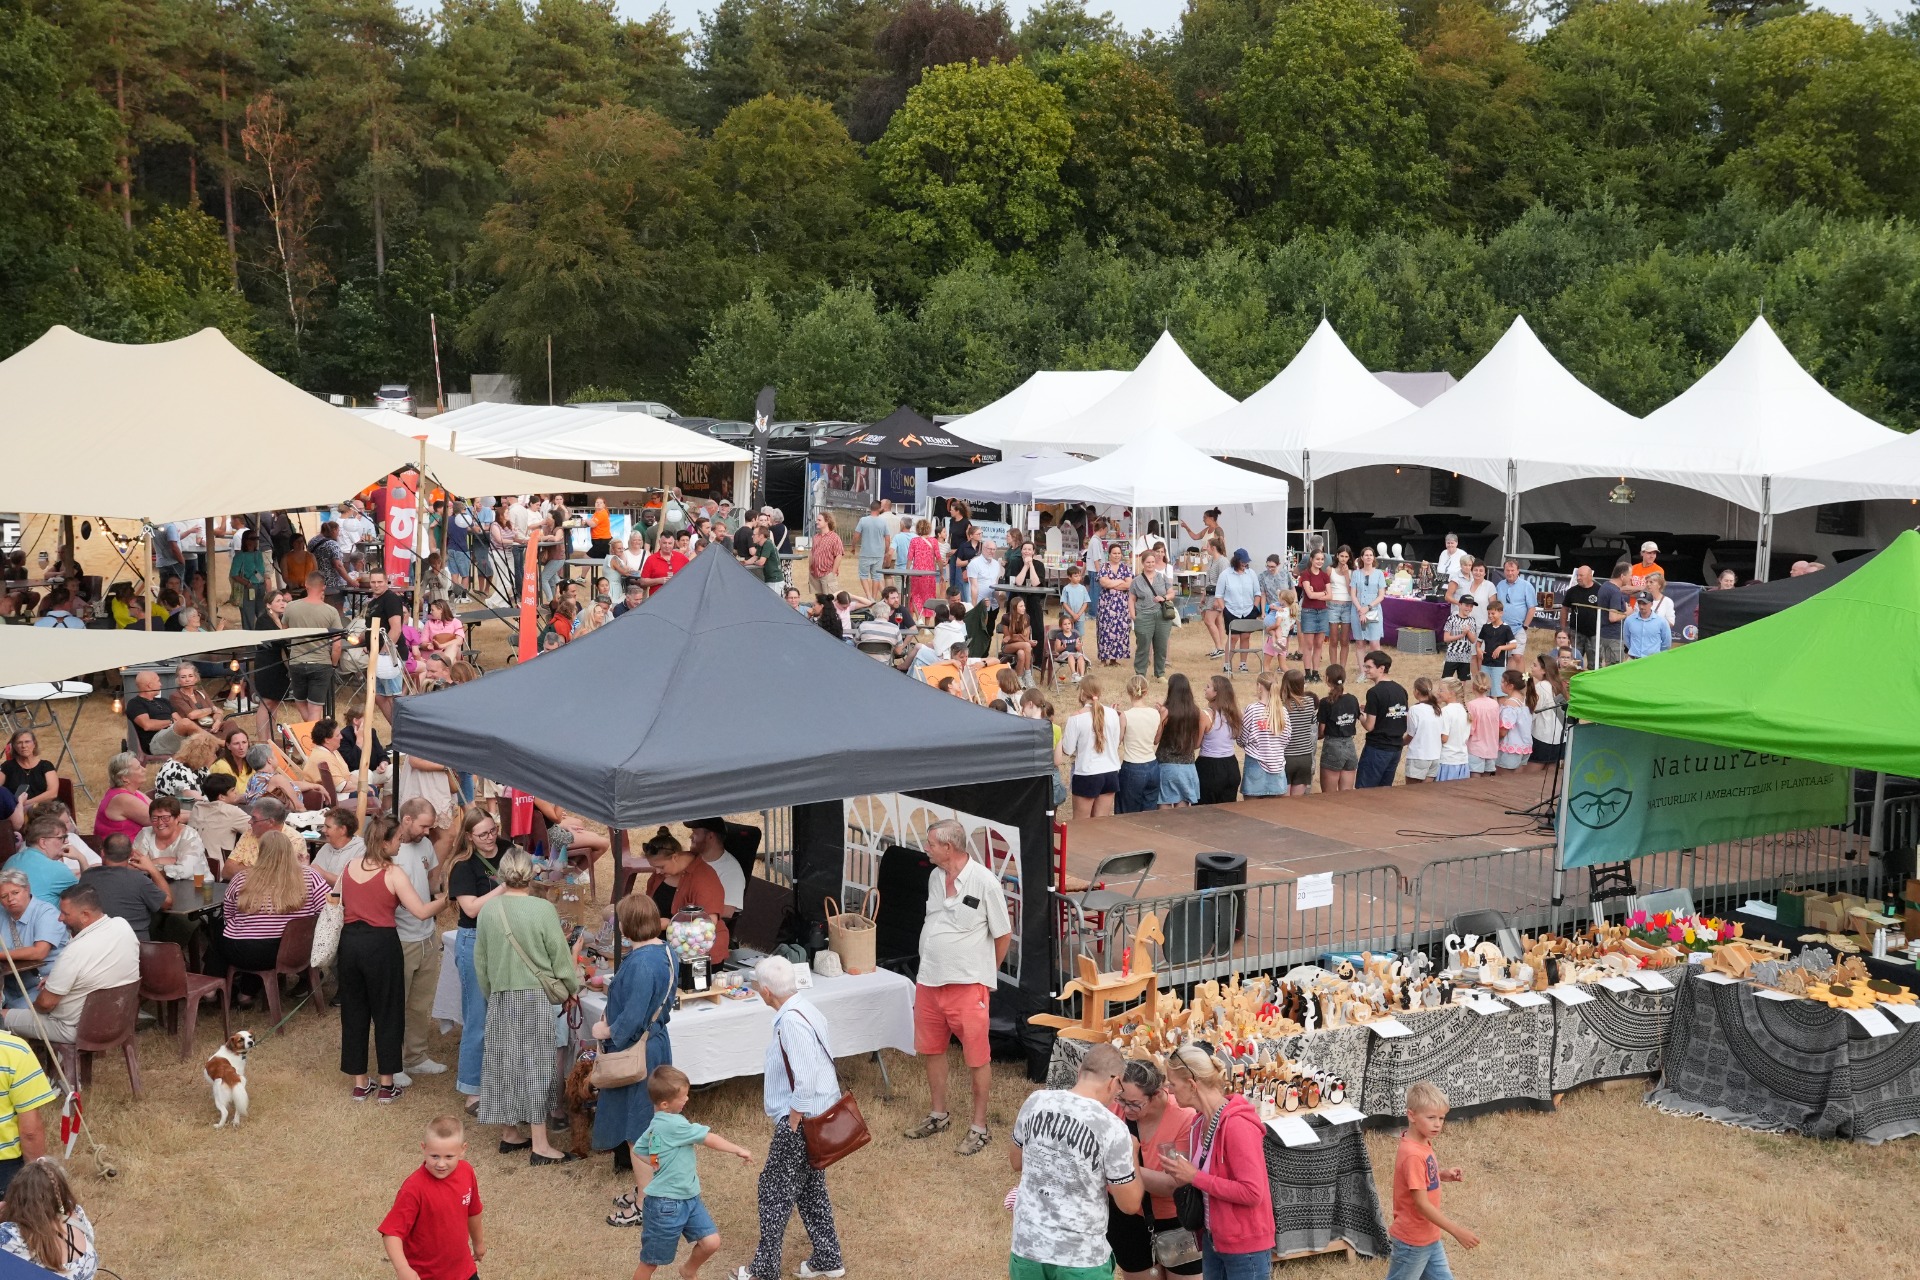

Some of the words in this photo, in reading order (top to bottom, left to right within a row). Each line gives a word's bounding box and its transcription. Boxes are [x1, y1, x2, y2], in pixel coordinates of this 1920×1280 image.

[920, 436, 952, 445] TRENDY
[1705, 782, 1772, 799] AMBACHTELIJK
[1298, 892, 1306, 900] 20
